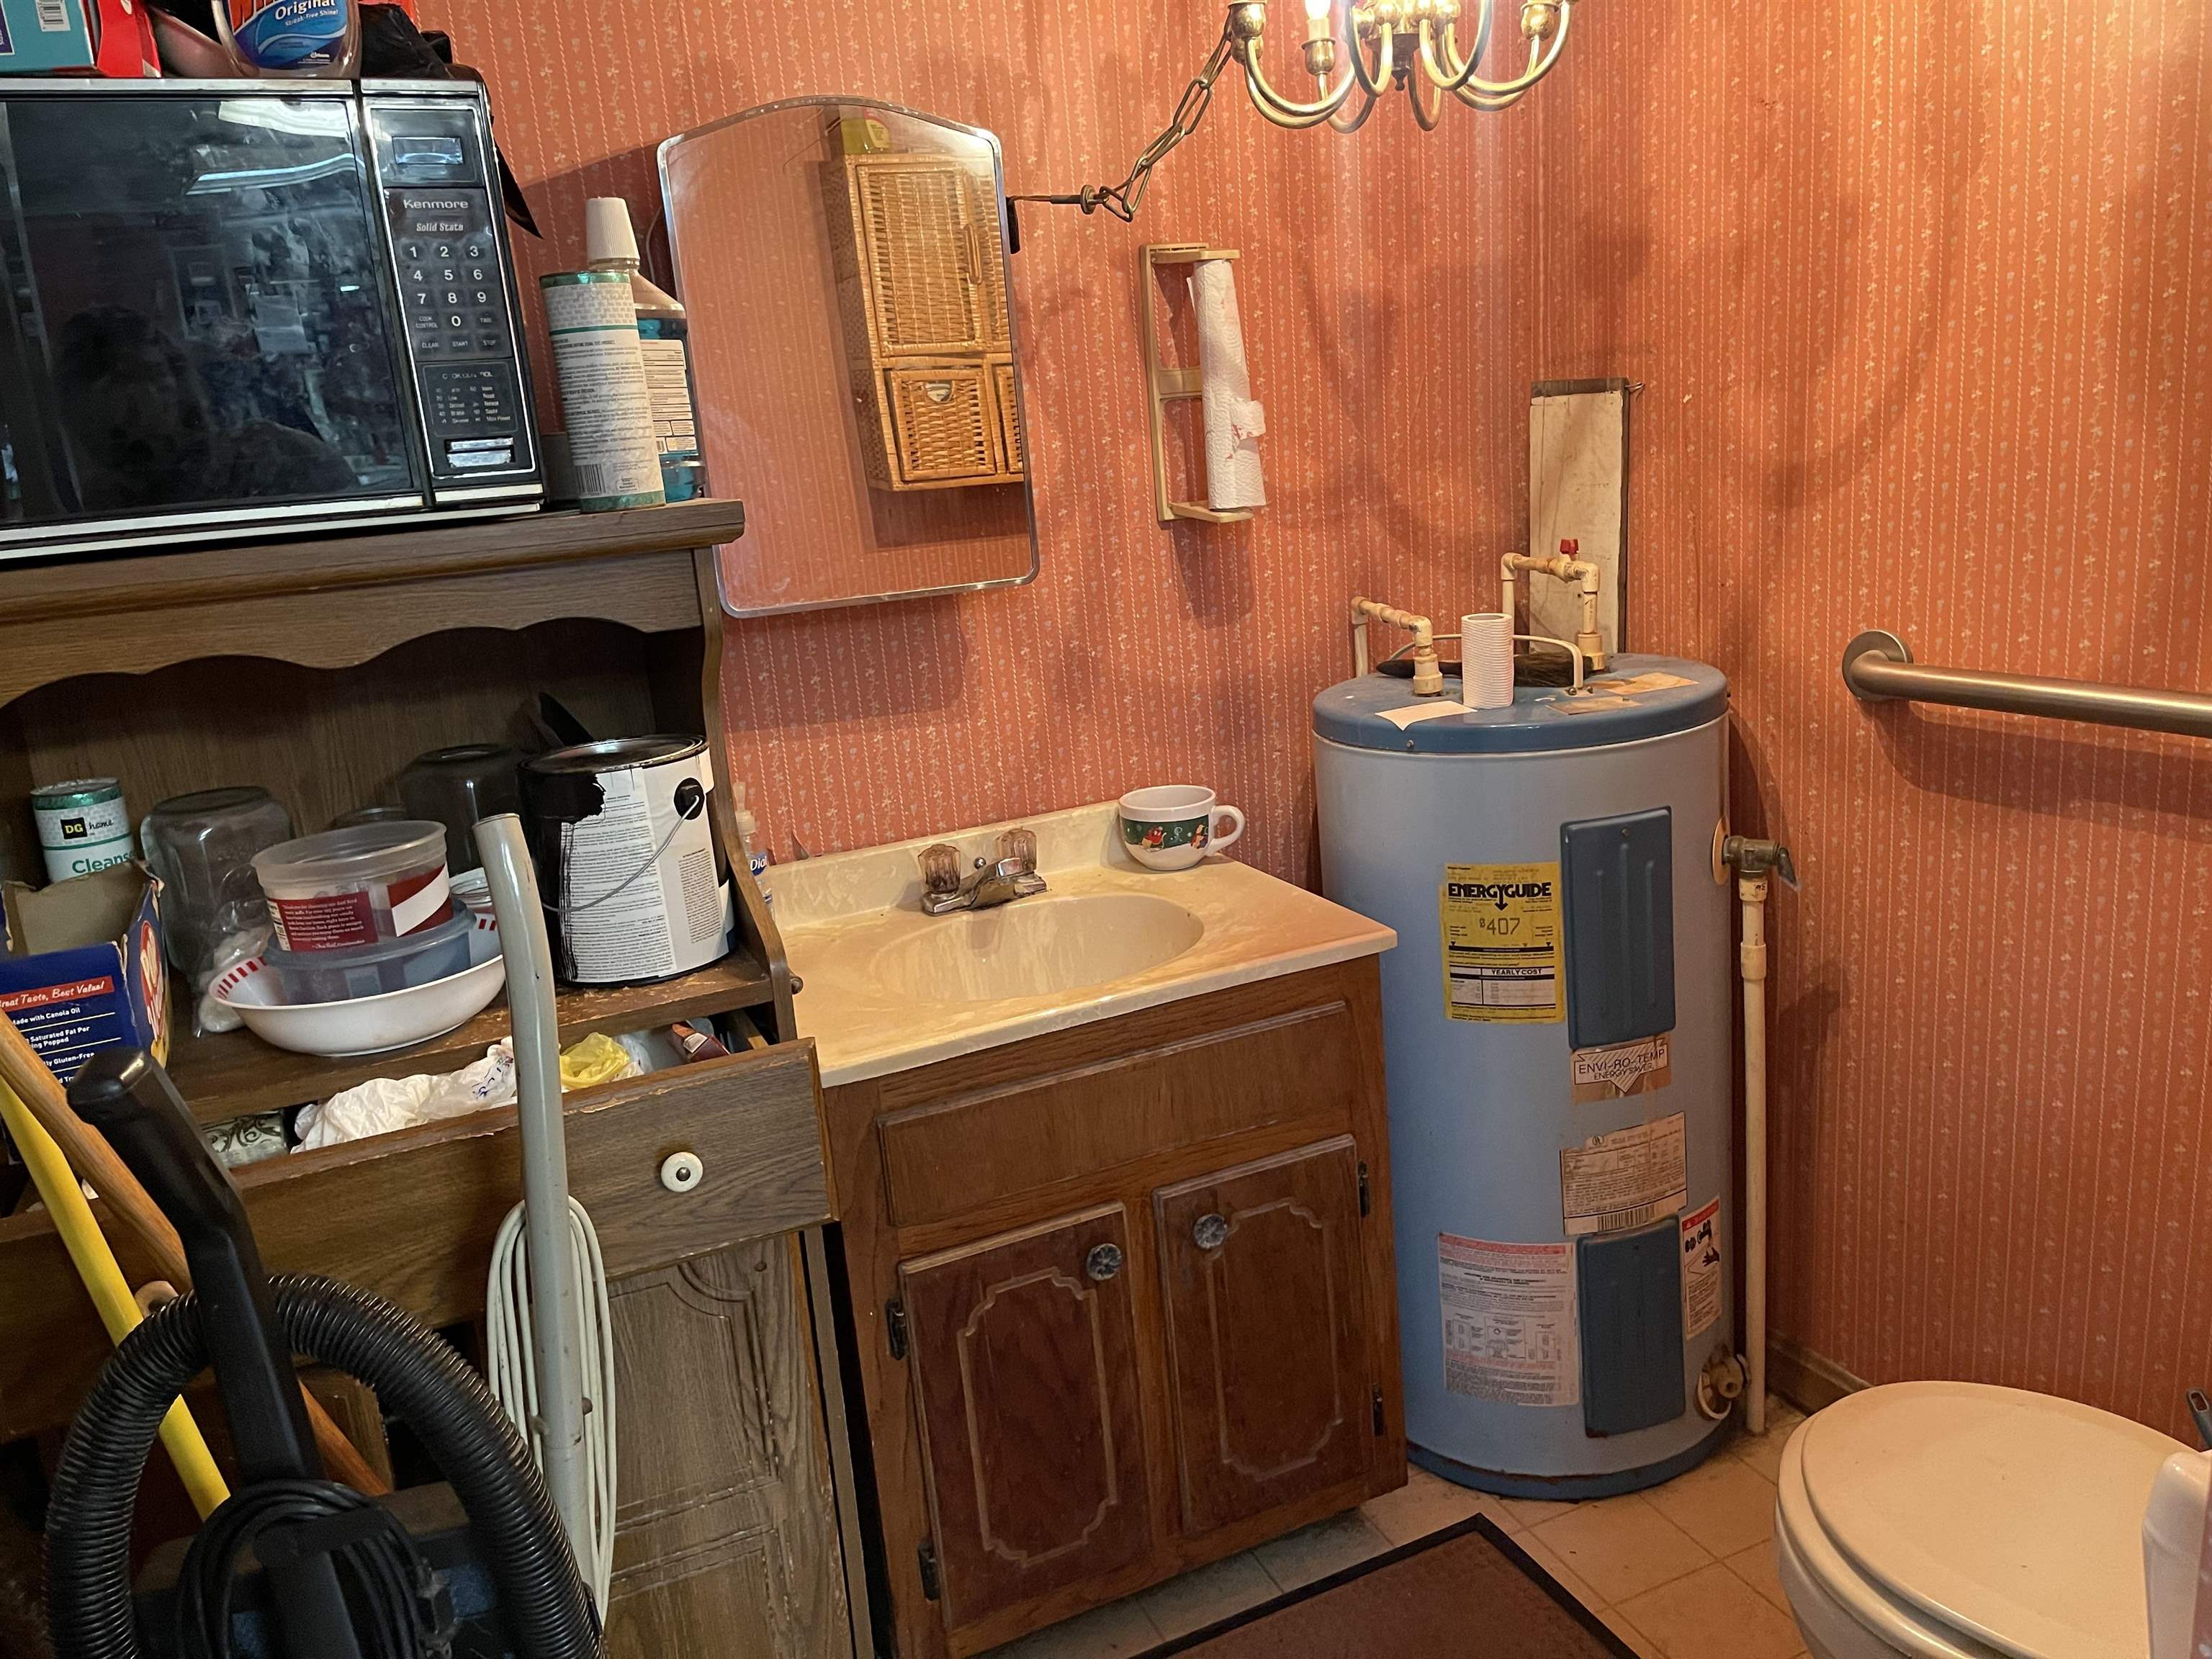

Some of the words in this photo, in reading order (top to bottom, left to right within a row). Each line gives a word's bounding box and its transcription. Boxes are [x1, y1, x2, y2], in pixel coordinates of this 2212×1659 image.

[275, 0, 336, 20] Original
[403, 199, 468, 209] Kenmore
[416, 222, 437, 232] Solid
[439, 222, 464, 232] State
[409, 246, 417, 257] 1
[440, 246, 449, 257] 2
[469, 246, 479, 256] 3
[413, 270, 423, 281] 4
[444, 269, 453, 280] 5
[473, 269, 482, 280] 6
[417, 293, 426, 304] 7
[448, 292, 457, 303] 8
[477, 292, 486, 302] 9
[451, 315, 461, 326] 0
[64, 824, 84, 835] DG
[89, 819, 114, 830] home
[750, 855, 767, 871] Dial
[20, 993, 49, 1004] Taste,
[52, 988, 75, 999] Best
[76, 981, 104, 994] Value!
[45, 1010, 70, 1019] Canola
[30, 1030, 64, 1043] Saturated
[43, 1037, 69, 1046] Popped
[53, 1052, 95, 1064] Gluten-Free
[1578, 1048, 1665, 1074] ENVI-RO-TEMP
